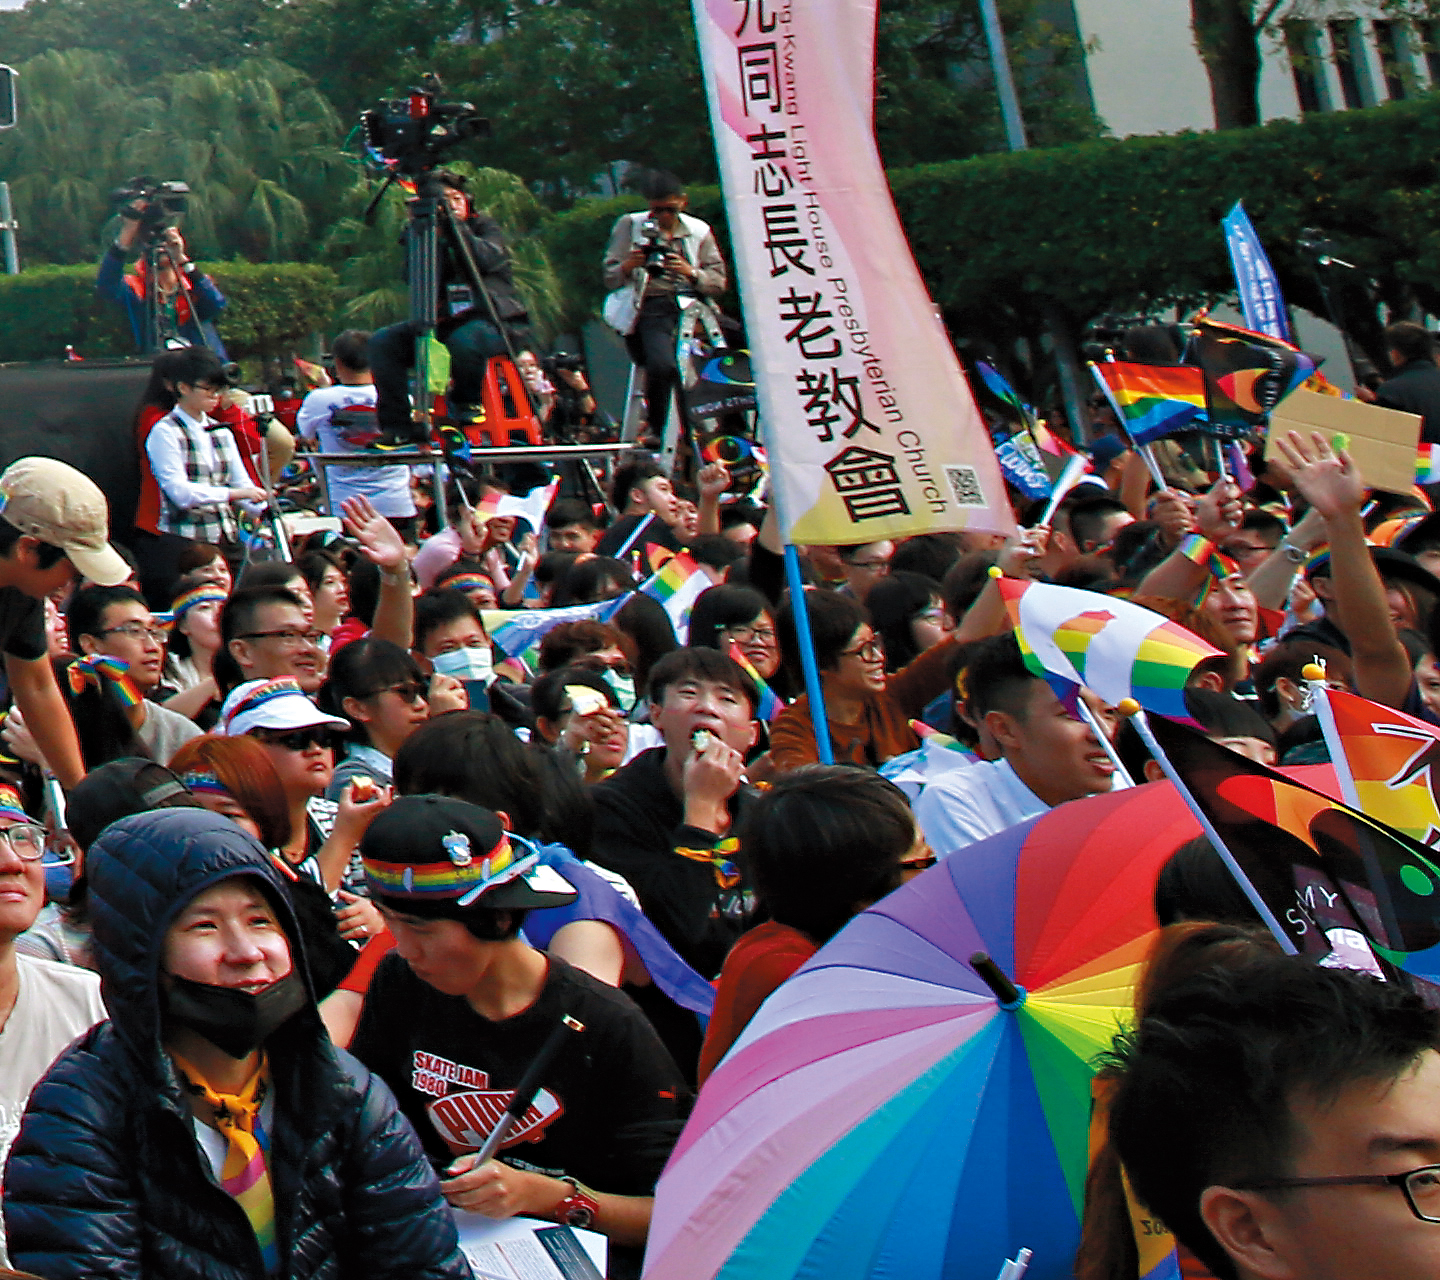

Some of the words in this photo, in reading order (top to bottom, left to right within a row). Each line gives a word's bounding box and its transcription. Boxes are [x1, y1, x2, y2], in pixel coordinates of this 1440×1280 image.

[790, 123, 813, 183] Light
[803, 190, 832, 270] House
[831, 280, 902, 423] Presbyterian
[897, 426, 947, 515] Church
[413, 1070, 447, 1096] 1980
[414, 1051, 456, 1080] SKATE
[457, 1064, 488, 1090] JAM
